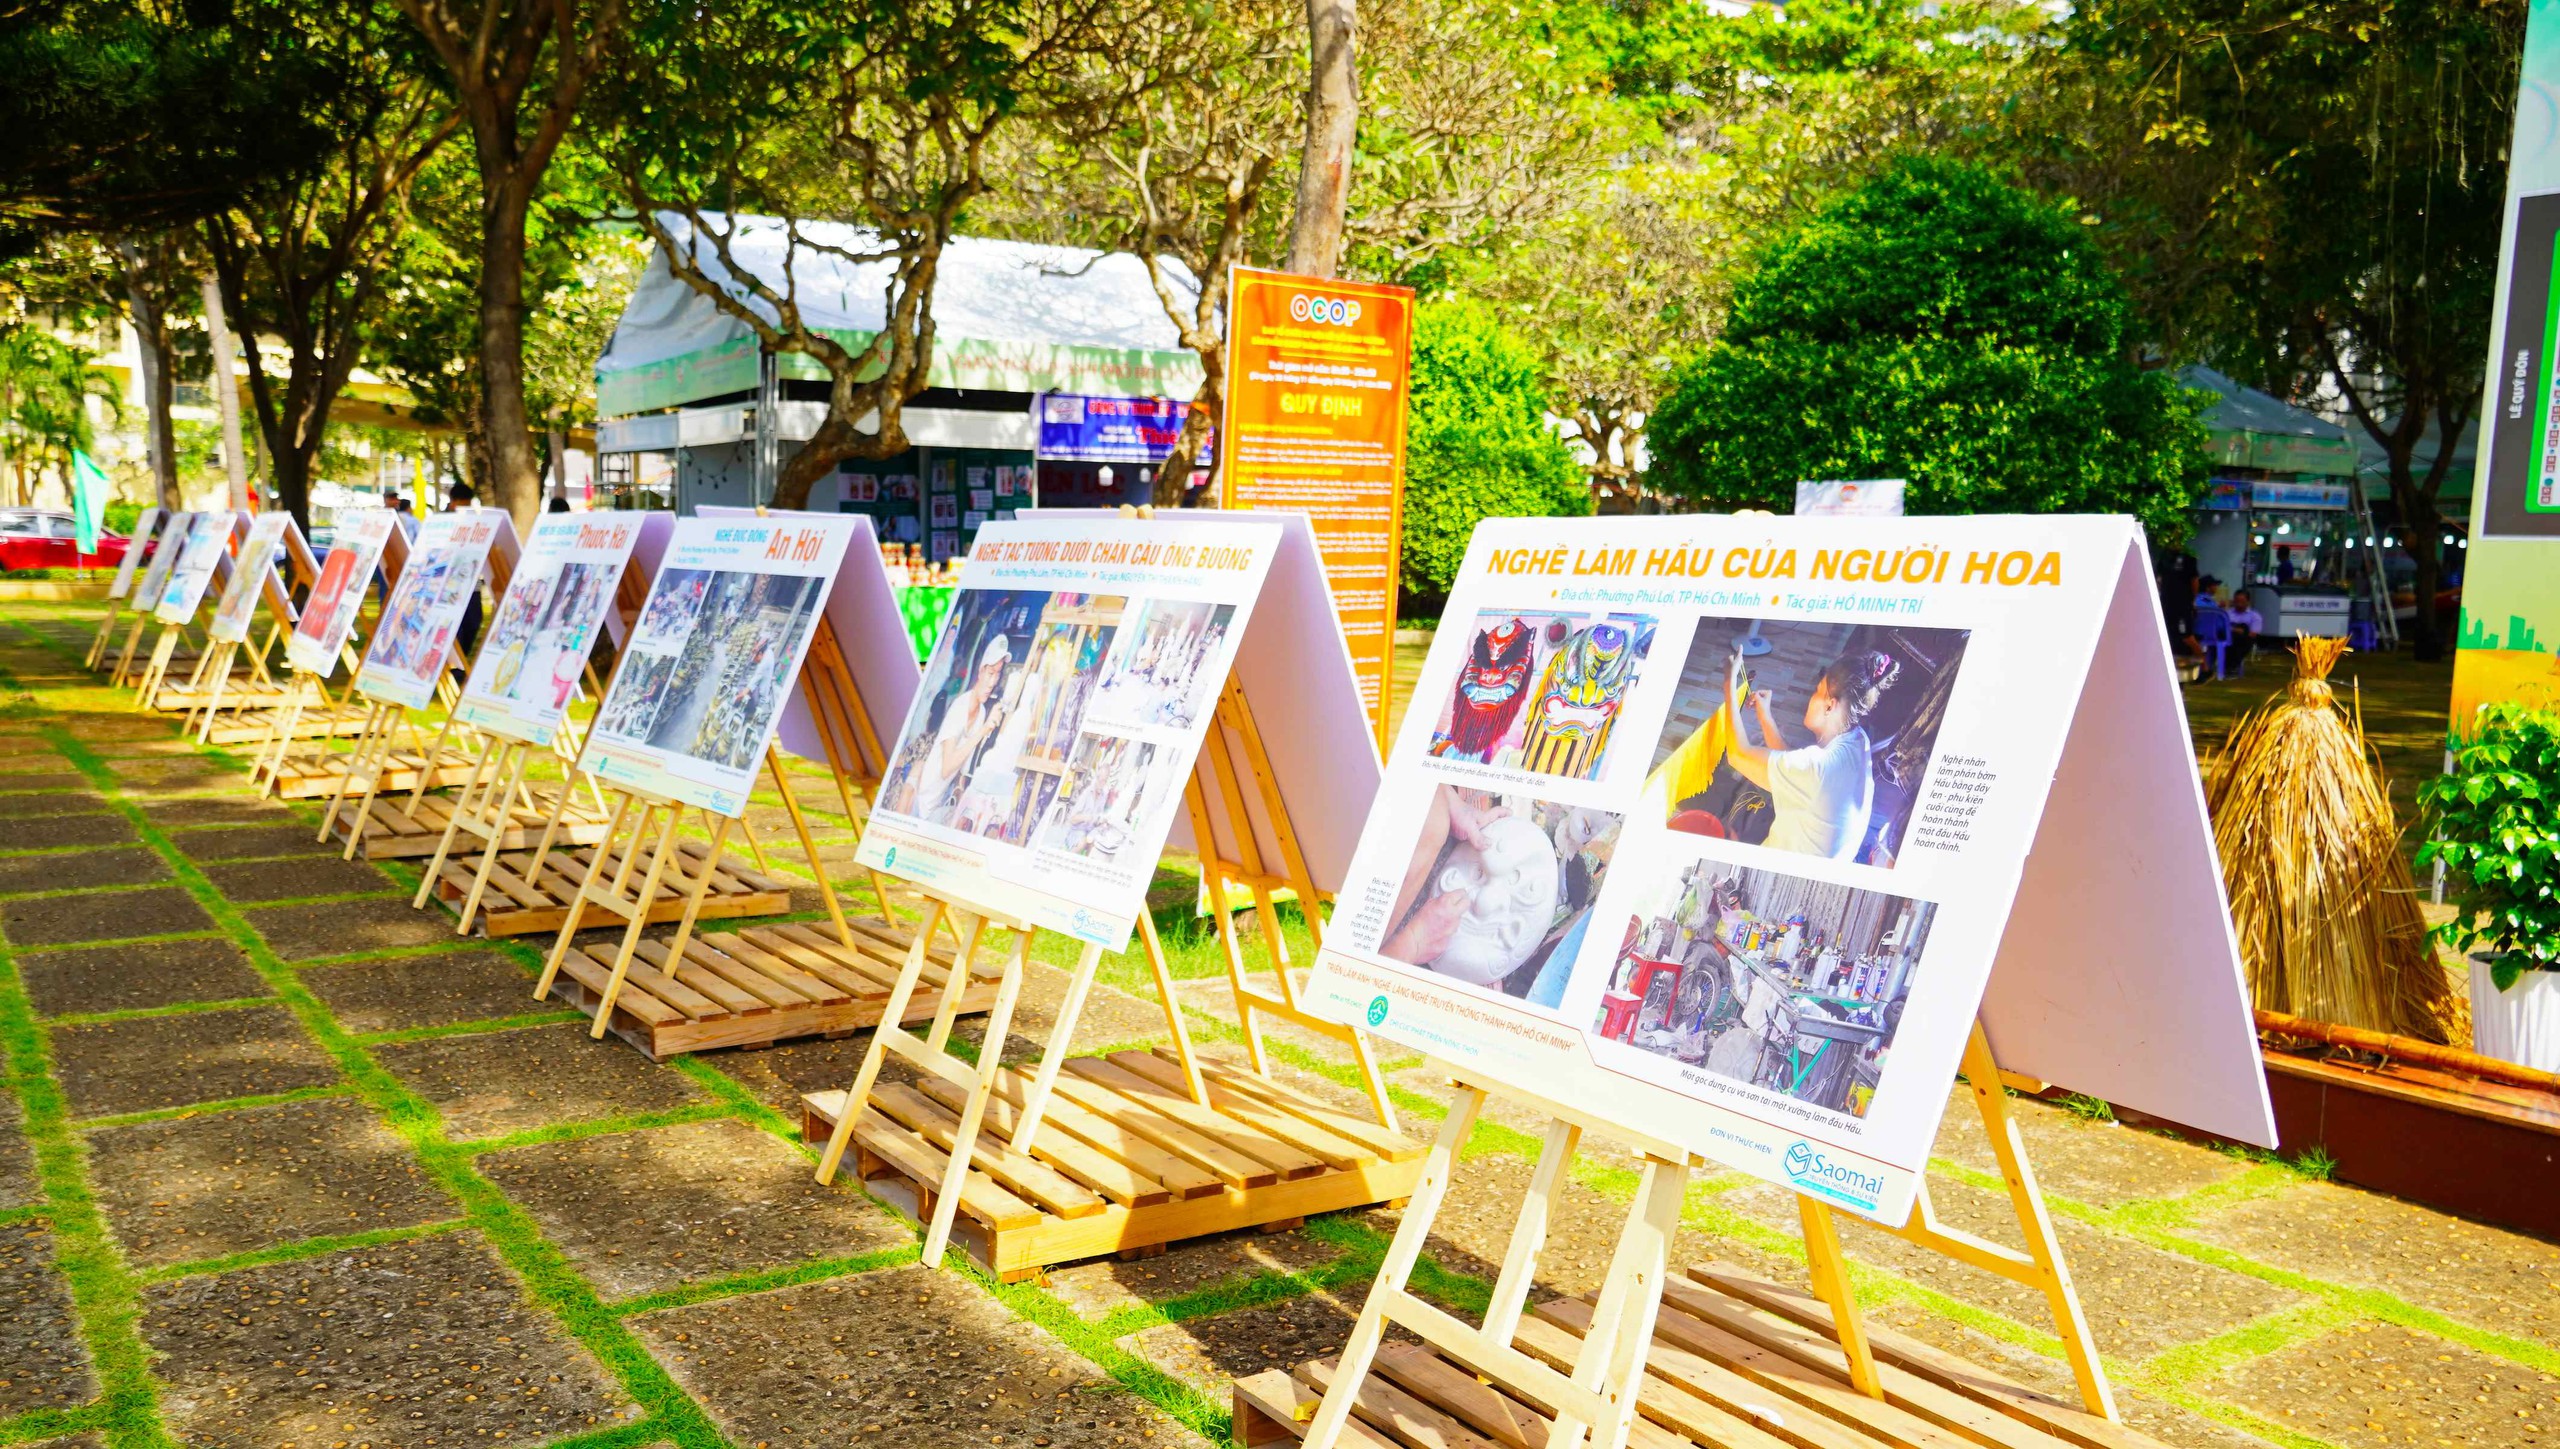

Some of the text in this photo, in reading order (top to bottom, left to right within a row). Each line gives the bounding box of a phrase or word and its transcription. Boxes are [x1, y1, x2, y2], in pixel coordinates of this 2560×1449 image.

[1291, 294, 1361, 327] OCOP
[1280, 392, 1362, 420] QUY ĐỊNH
[2509, 403, 2522, 419] LÊ
[764, 528, 791, 560] An
[791, 527, 826, 568] Hội
[975, 539, 1002, 563] NGHỀ
[1059, 538, 1092, 563] DƯỚI
[1092, 539, 1127, 565] CHÂN
[1162, 540, 1196, 569] ÔNG
[1487, 539, 2062, 586] NGHỀ LÀM HẨU CỦA NGƯỜI HOA
[1596, 588, 1634, 605] Phường
[1678, 591, 1692, 604] TP
[1731, 591, 1761, 607] Minh
[1785, 594, 1805, 609] Tác
[1857, 596, 1898, 613] MINH
[1900, 595, 1926, 614] TRÍ
[1937, 766, 1953, 776] làm
[1964, 757, 1986, 767] nhân
[1929, 789, 1943, 799] len
[1922, 813, 1969, 828] hoàn thành
[1913, 837, 1935, 849] hoàn
[1480, 1011, 1506, 1030] THÀNH
[1812, 1111, 1827, 1124] làm
[1811, 1154, 1884, 1195] Saomai
